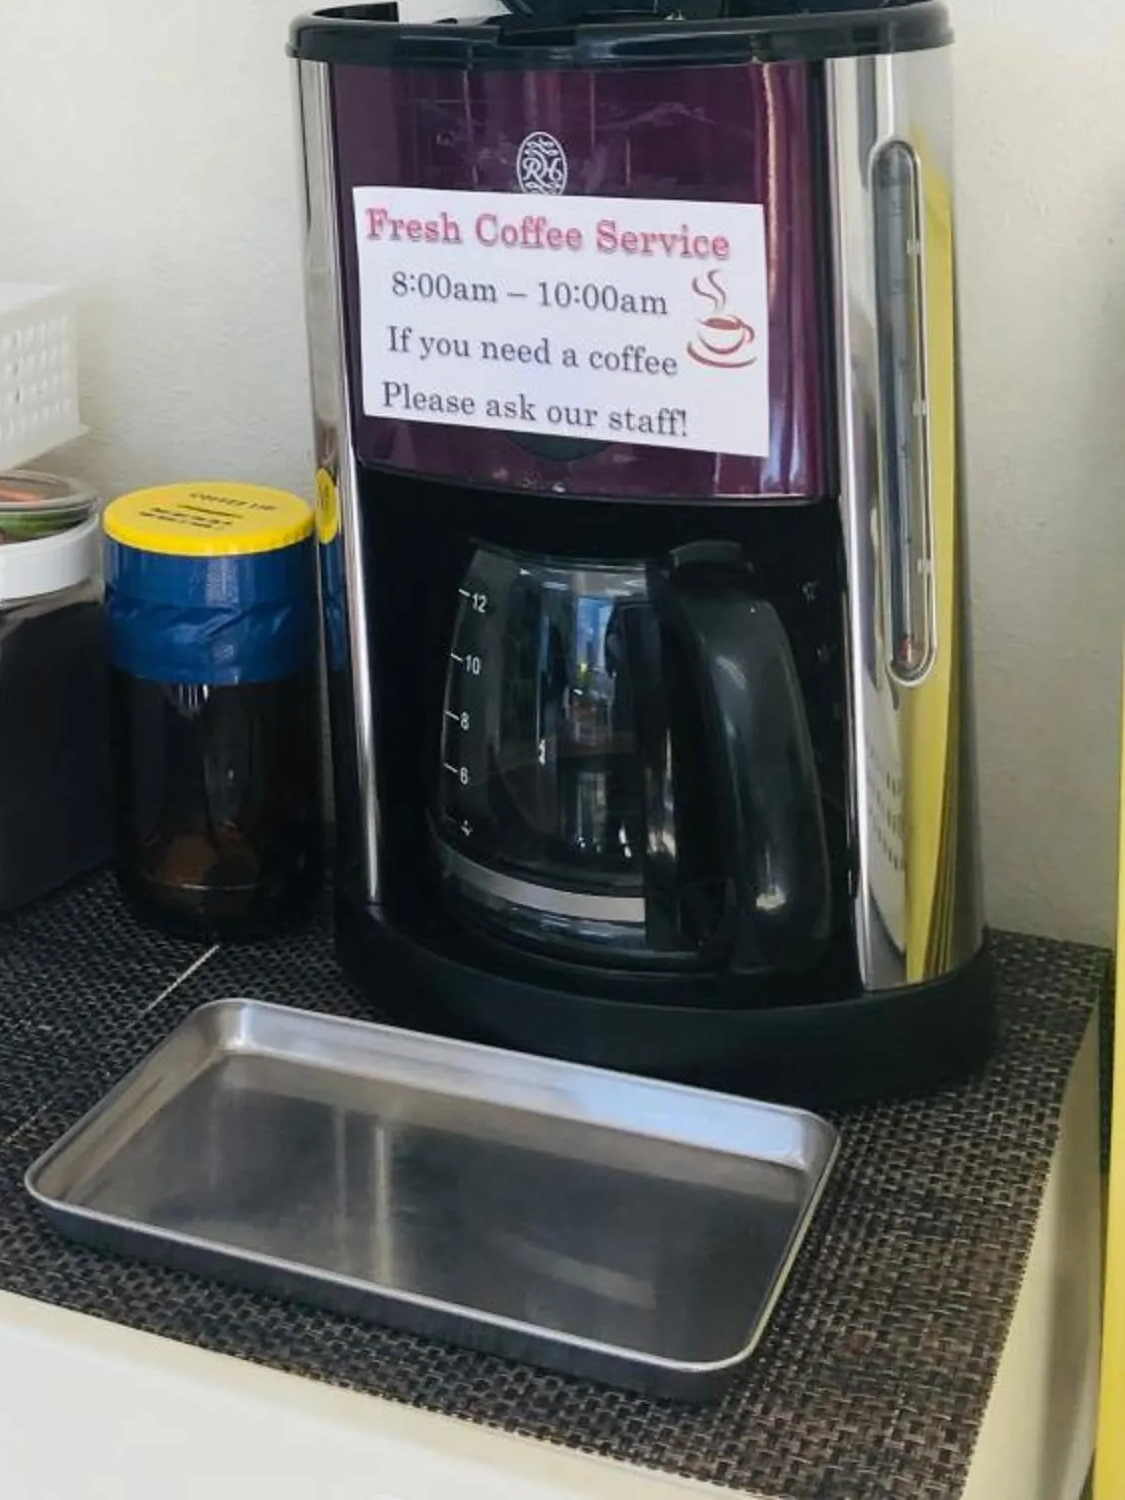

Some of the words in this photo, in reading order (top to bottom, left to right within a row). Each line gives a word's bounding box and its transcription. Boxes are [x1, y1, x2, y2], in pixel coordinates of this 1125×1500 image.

[366, 208, 463, 246] Fresh
[474, 213, 583, 251] Coffee
[595, 219, 731, 260] Service
[392, 270, 496, 303] 8:00am
[538, 281, 668, 316] 10:00am
[387, 325, 412, 352] If
[419, 338, 470, 361] you
[480, 339, 551, 366] need
[562, 351, 579, 368] a
[589, 345, 678, 376] coffee
[382, 381, 475, 415] Please
[485, 393, 537, 421] ask
[547, 404, 598, 428] our
[608, 409, 688, 437] staff!
[472, 593, 487, 613] 12
[466, 654, 481, 675] 10
